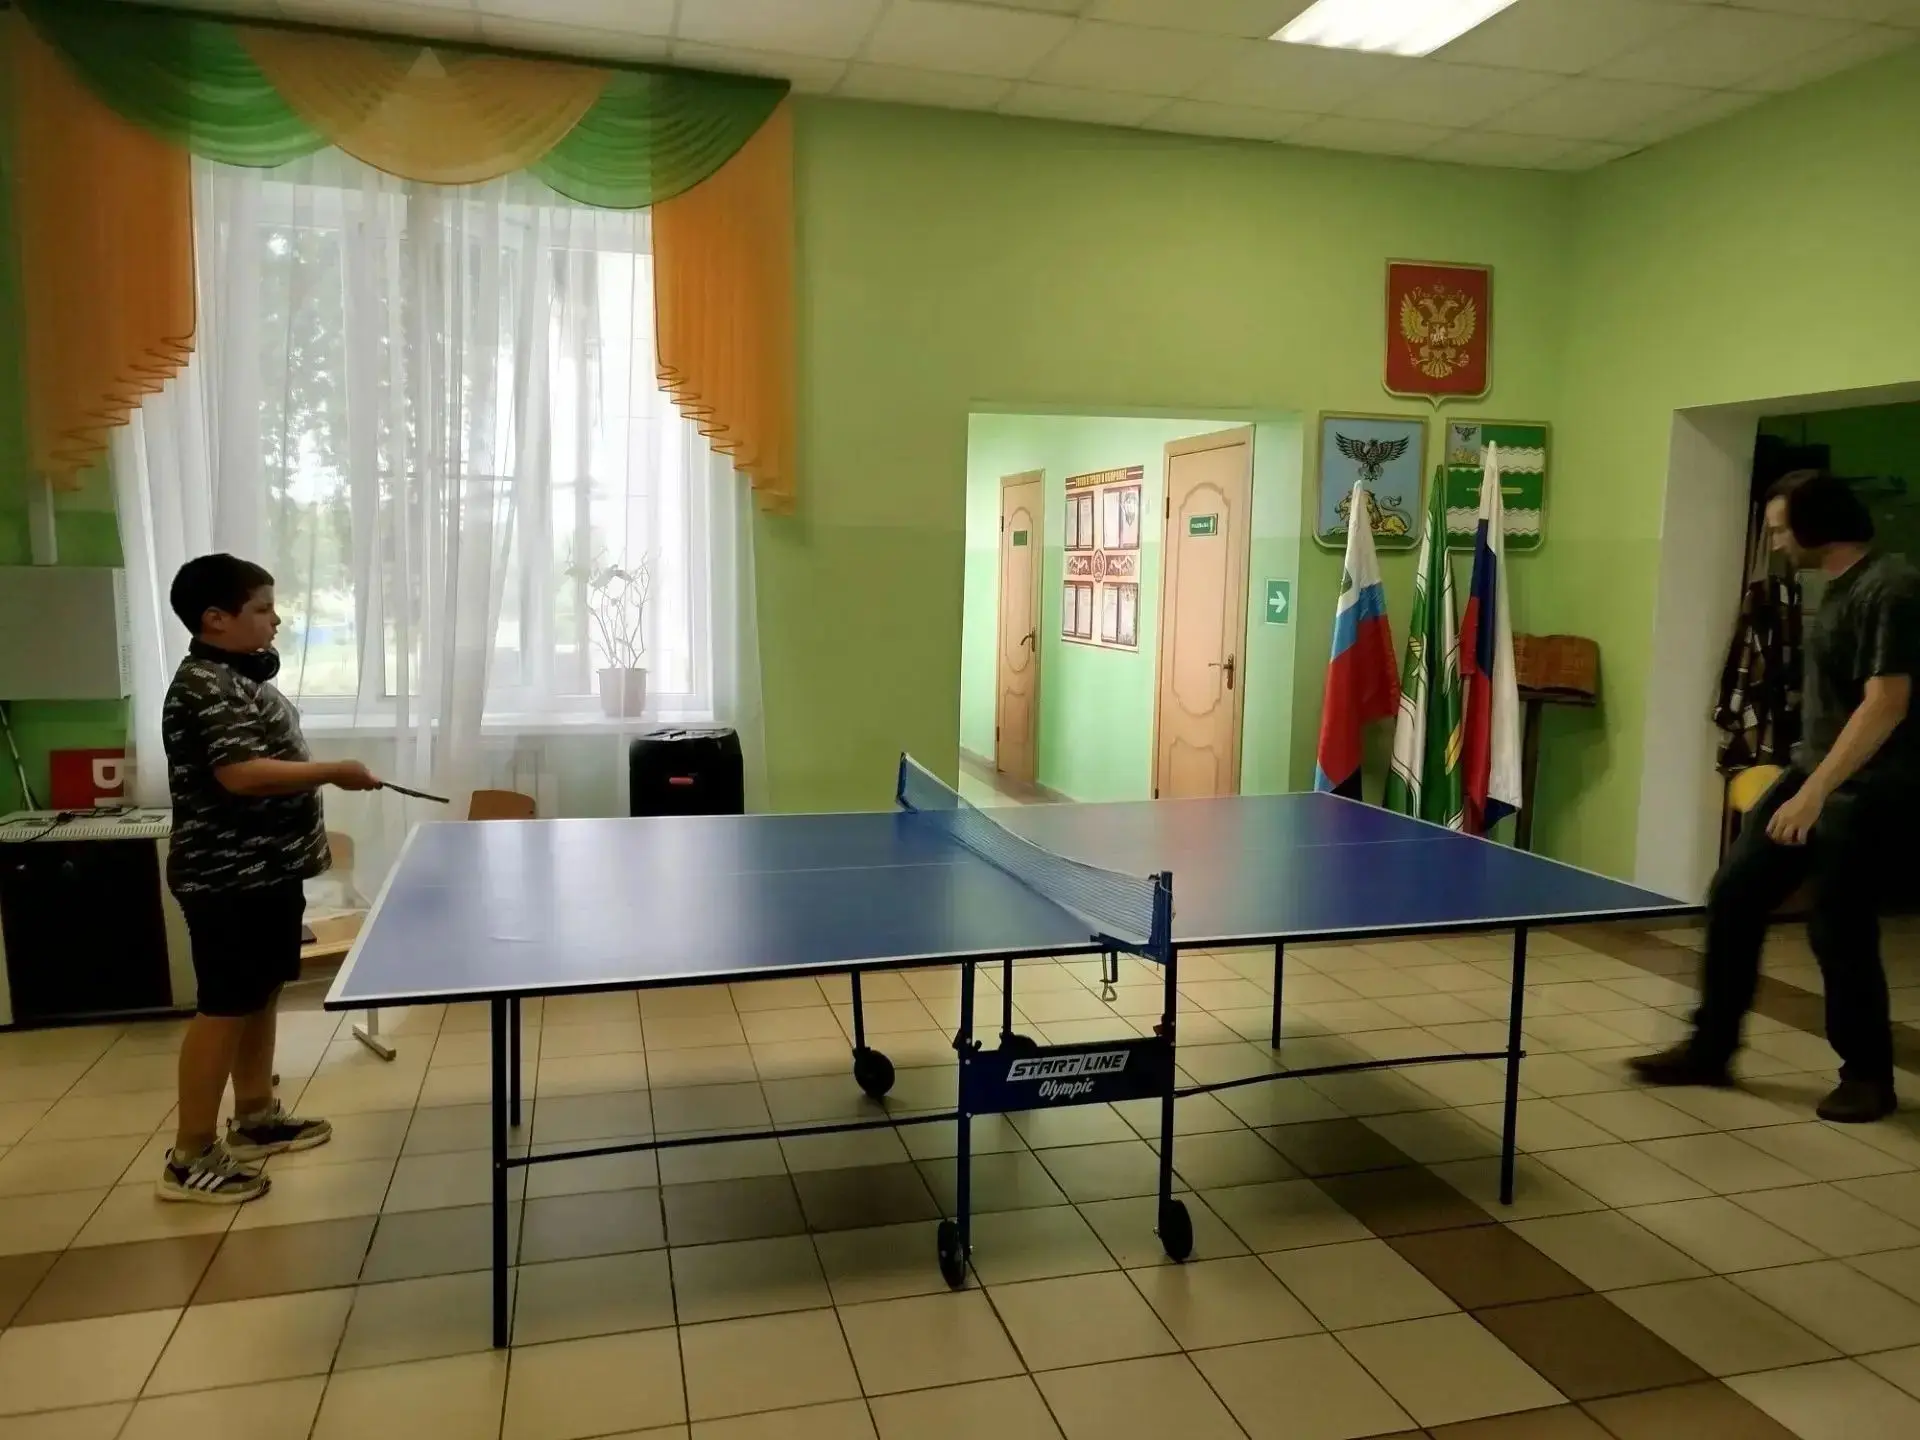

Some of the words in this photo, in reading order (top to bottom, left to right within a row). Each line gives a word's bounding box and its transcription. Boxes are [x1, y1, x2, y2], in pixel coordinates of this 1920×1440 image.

[1011, 1057, 1082, 1077] START
[1083, 1054, 1125, 1071] LINE
[1038, 1078, 1095, 1100] Olympic
